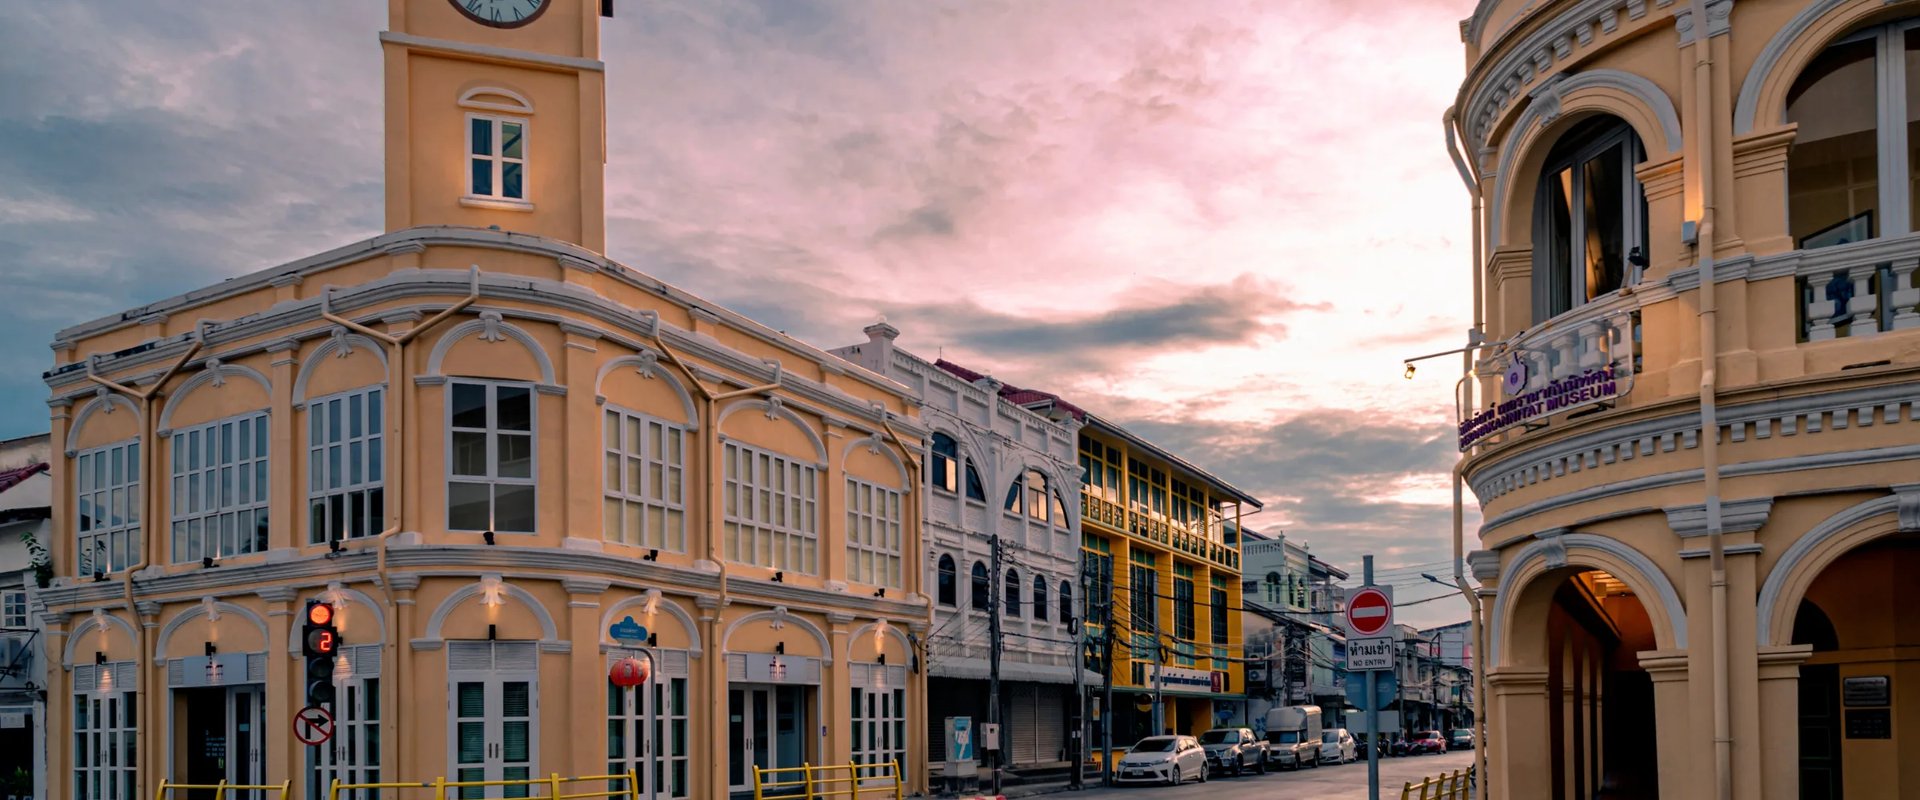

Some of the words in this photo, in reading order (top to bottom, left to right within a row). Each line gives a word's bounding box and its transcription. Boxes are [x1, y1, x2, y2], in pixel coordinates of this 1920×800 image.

[1546, 381, 1616, 412] MUSEUM
[320, 632, 332, 651] 2
[1349, 640, 1391, 656] ห้ามเข้า
